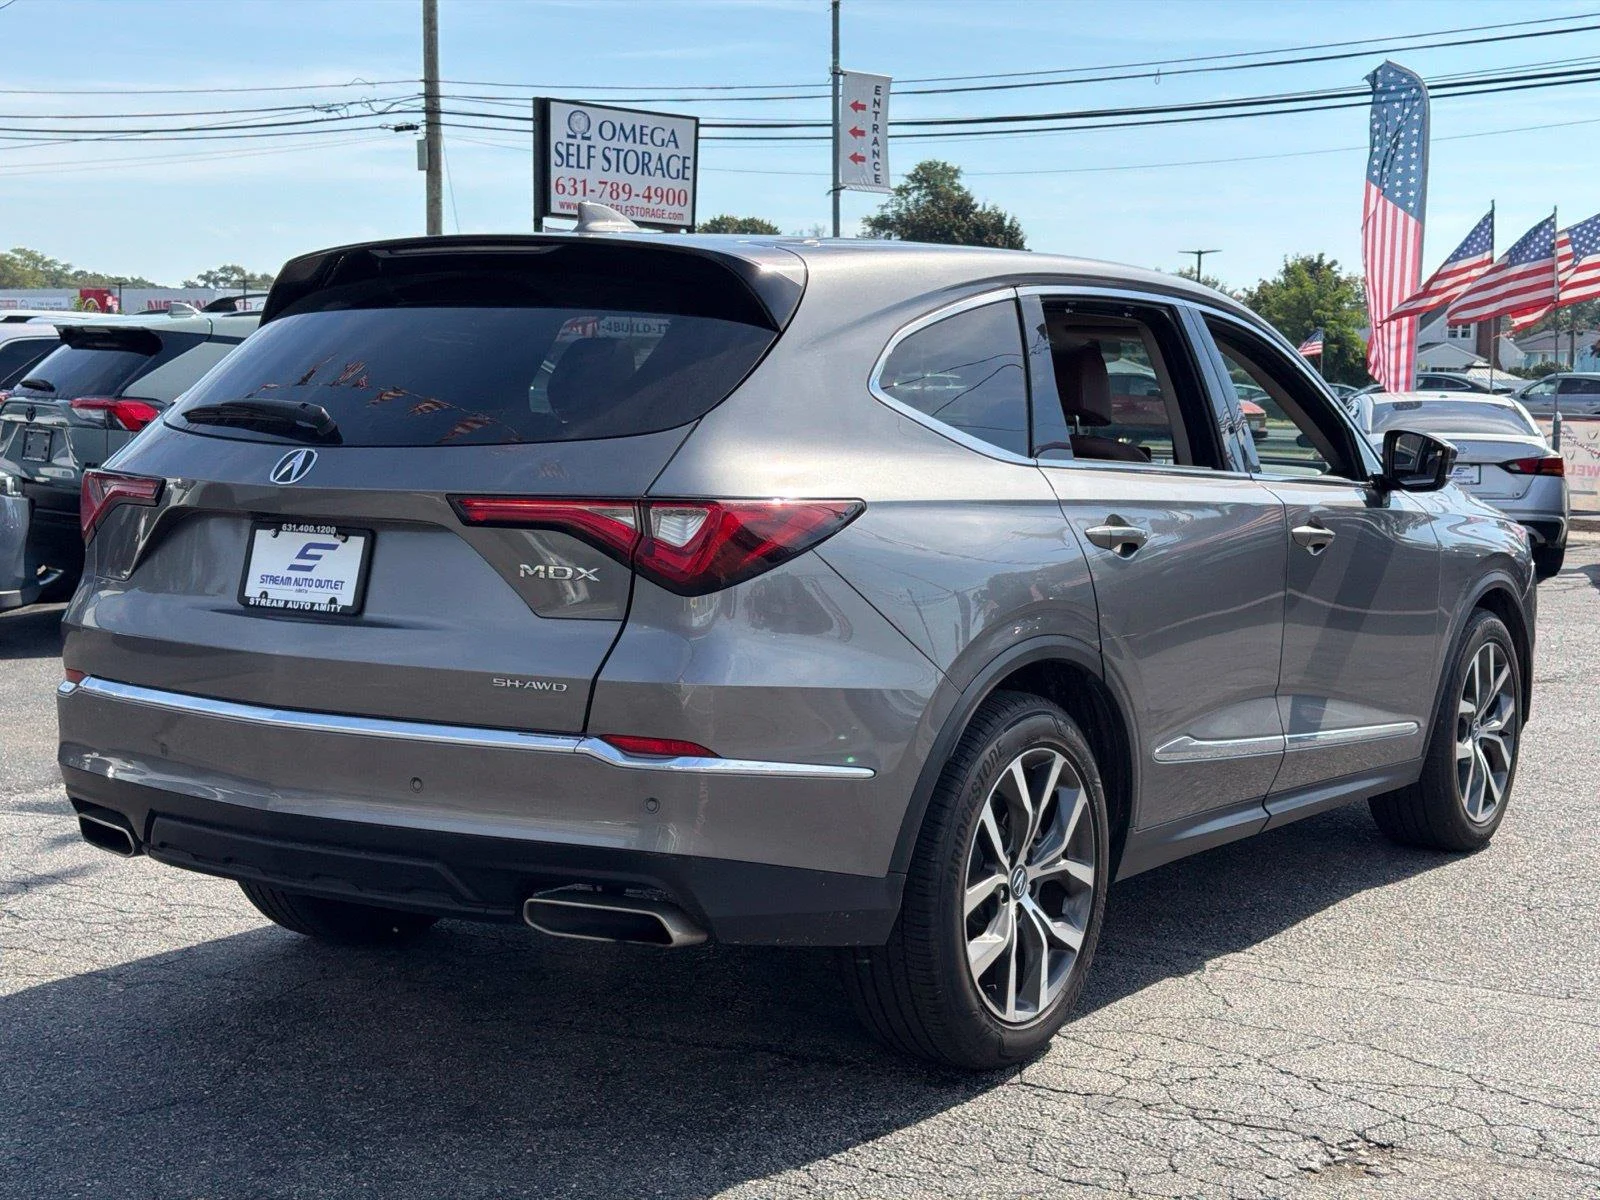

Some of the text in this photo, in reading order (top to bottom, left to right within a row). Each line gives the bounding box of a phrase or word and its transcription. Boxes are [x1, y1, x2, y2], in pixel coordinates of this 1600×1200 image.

[598, 120, 680, 149] OMEGA
[872, 85, 882, 184] ENTRANCE
[554, 141, 691, 181] SELF STORAGE
[555, 176, 688, 207] 631-789-4900
[281, 523, 337, 534] 631.400.1200
[519, 564, 600, 582] MDX
[259, 574, 345, 591] STREAM AUTO OUTLET
[248, 597, 342, 613] STREAM AUTO AMITY
[492, 678, 568, 692] SH-AWD
